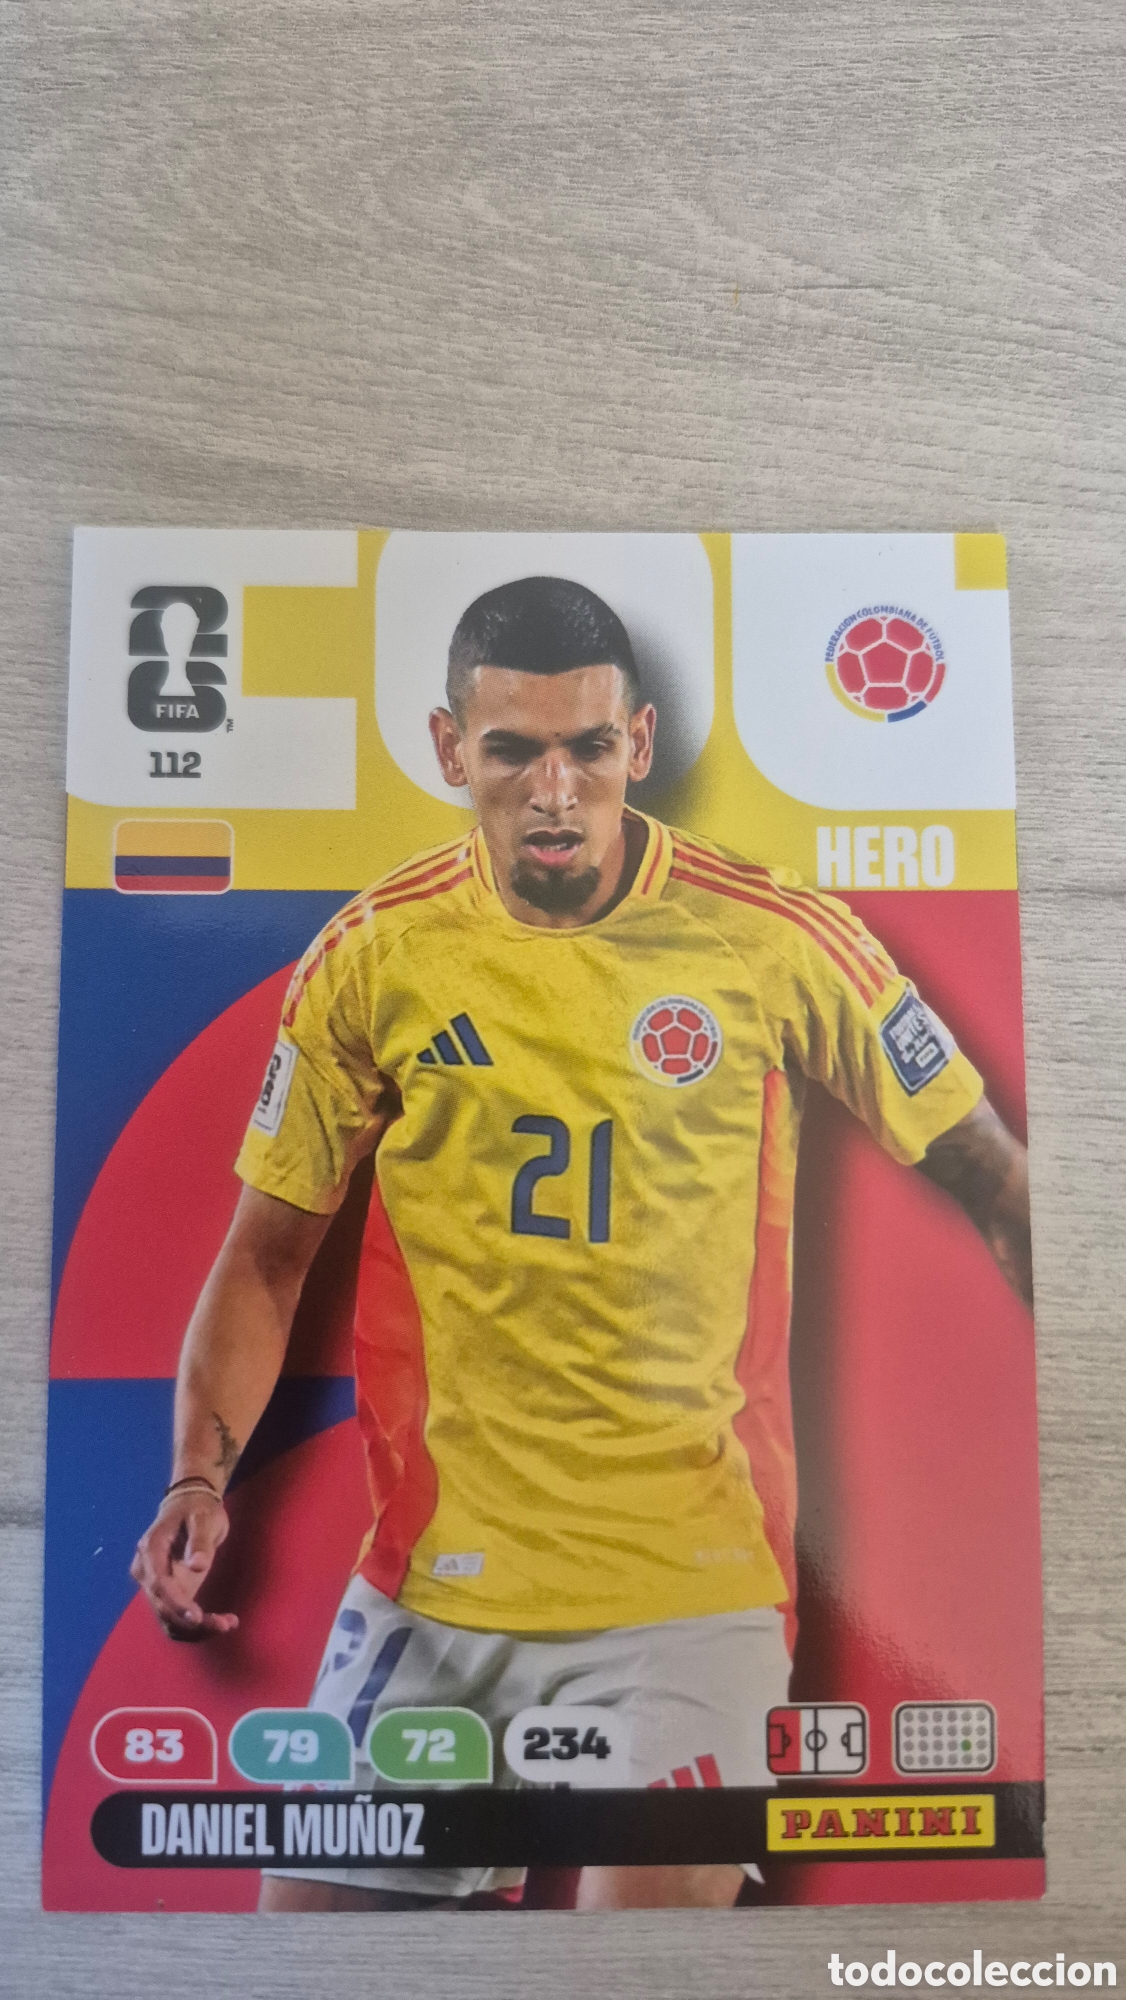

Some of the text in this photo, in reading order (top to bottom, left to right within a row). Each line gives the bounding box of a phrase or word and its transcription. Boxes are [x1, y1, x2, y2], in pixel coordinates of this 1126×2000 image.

[856, 605, 917, 623] COLOMBIANA
[916, 617, 928, 631] DE
[156, 704, 200, 719] FIFA
[149, 751, 202, 779] 112
[816, 825, 955, 887] HERO
[511, 1113, 613, 1243] 21
[124, 1727, 185, 1763] 83
[263, 1728, 320, 1764] 79
[401, 1728, 456, 1763] 72
[523, 1726, 612, 1761] 234
[140, 1793, 425, 1857] DANIEL MUÑOZ
[781, 1806, 982, 1838] PANINI
